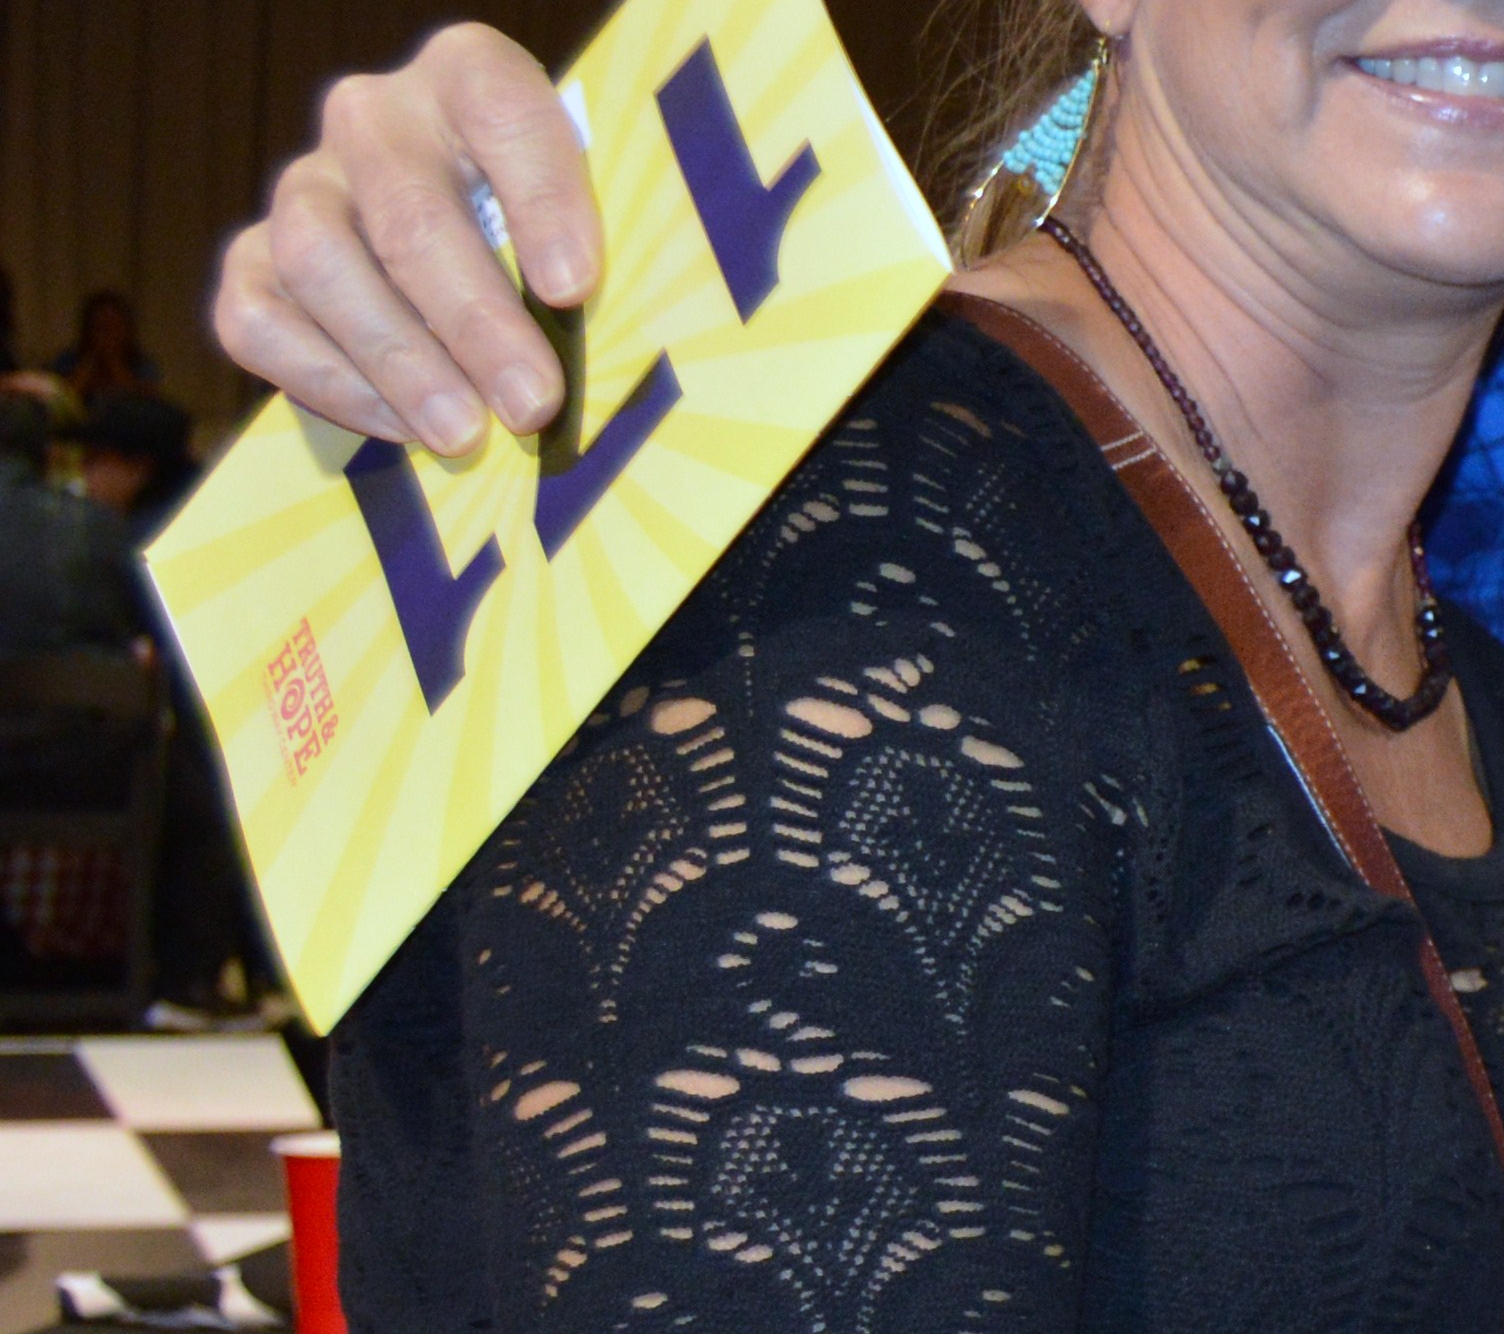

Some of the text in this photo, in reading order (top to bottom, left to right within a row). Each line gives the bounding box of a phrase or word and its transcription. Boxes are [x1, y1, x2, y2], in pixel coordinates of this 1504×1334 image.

[343, 33, 822, 716] 171
[267, 641, 322, 777] HOPE
[293, 615, 335, 724] TRUTH
